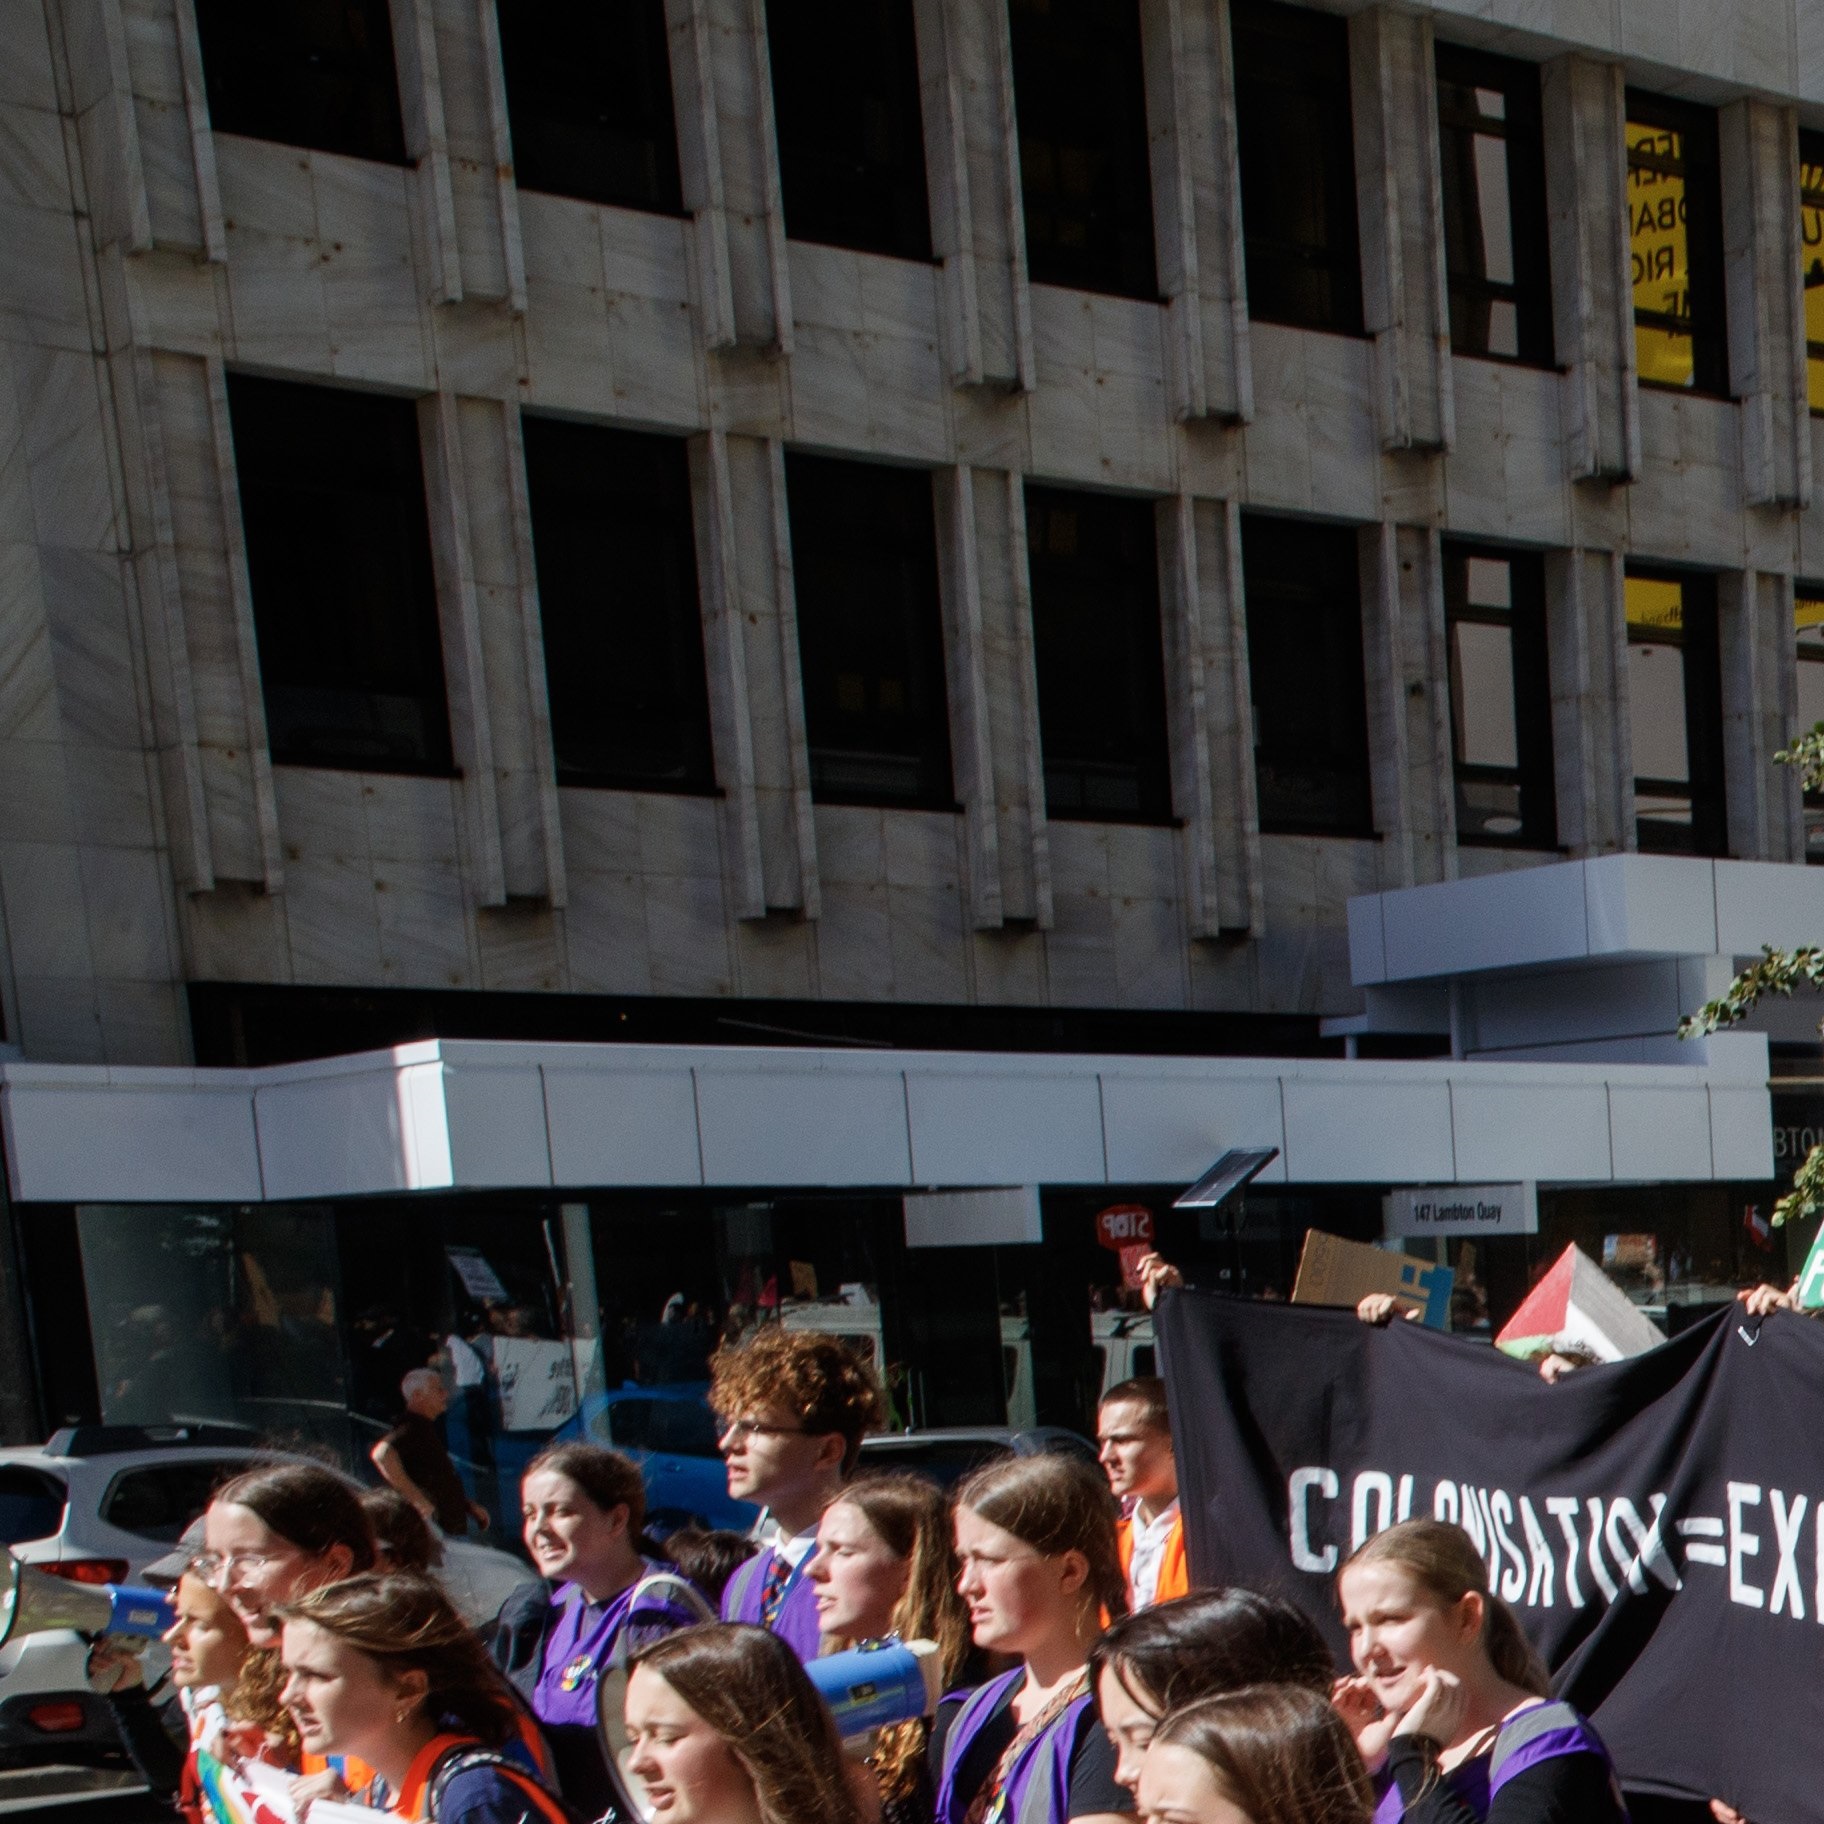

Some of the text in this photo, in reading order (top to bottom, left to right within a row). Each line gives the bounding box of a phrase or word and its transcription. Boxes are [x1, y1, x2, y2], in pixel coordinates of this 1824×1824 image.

[1414, 1201, 1502, 1224] 147 Lambton Quay
